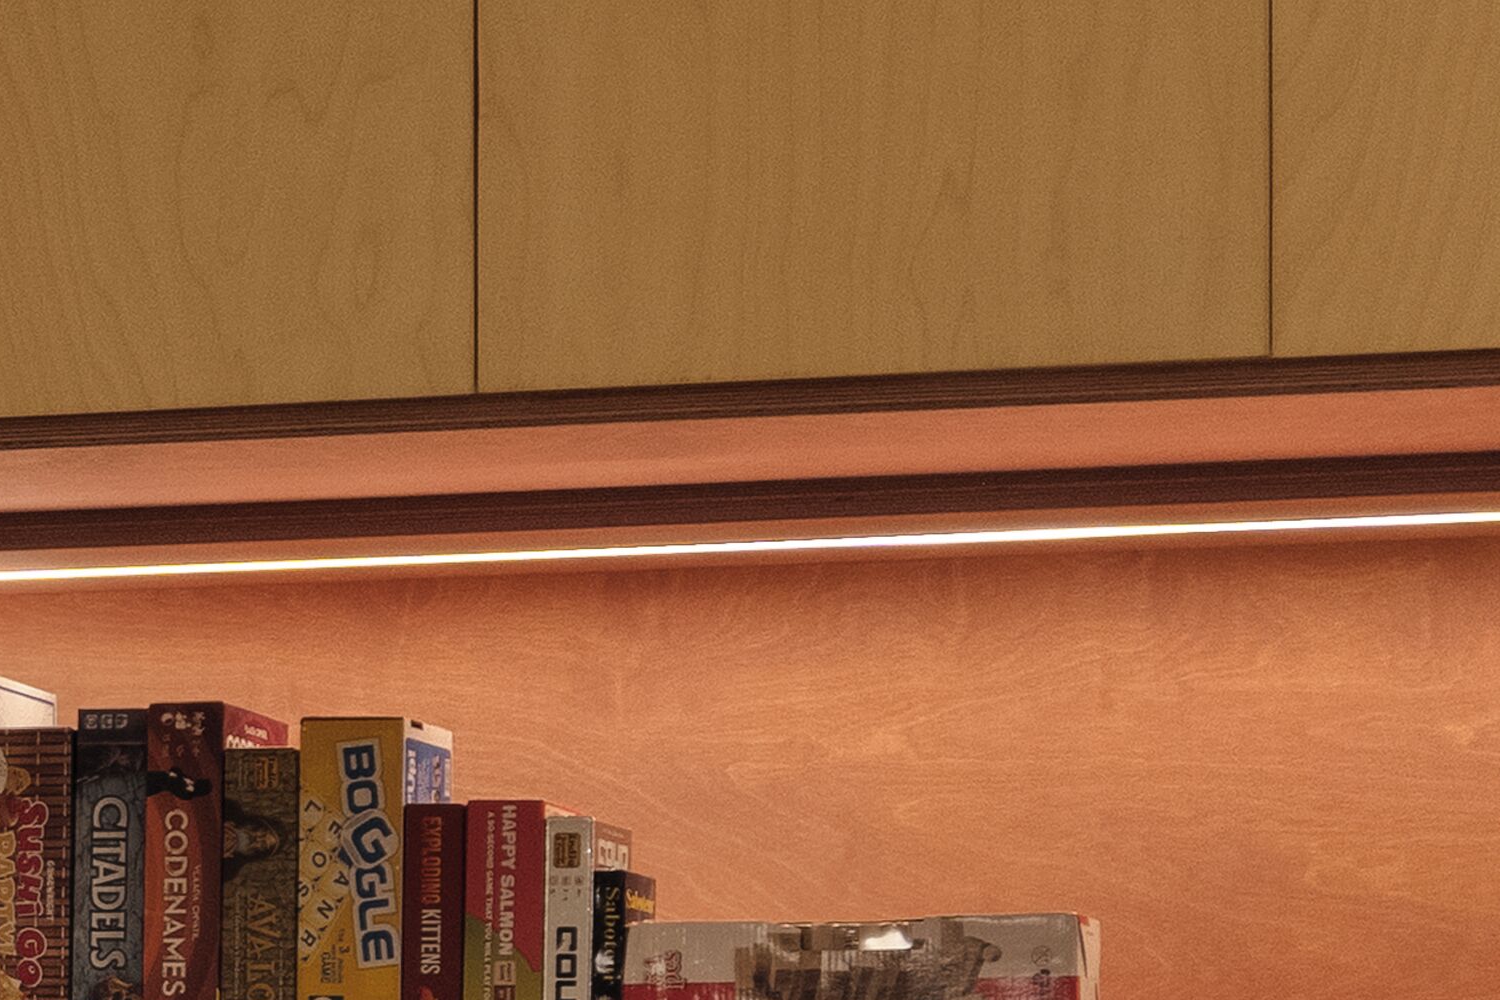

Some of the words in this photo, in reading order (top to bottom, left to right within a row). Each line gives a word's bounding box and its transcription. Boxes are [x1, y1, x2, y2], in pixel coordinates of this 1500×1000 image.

[16, 798, 49, 917] SUSHI
[343, 744, 395, 963] BOGGLE
[421, 816, 442, 904] EXPLODING
[501, 805, 517, 870] HAPPY
[89, 796, 129, 971] CITADELS
[162, 808, 189, 997] CODENAMES
[498, 874, 515, 956] SALMON
[16, 927, 48, 987] GO
[420, 908, 442, 975] KITTENS
